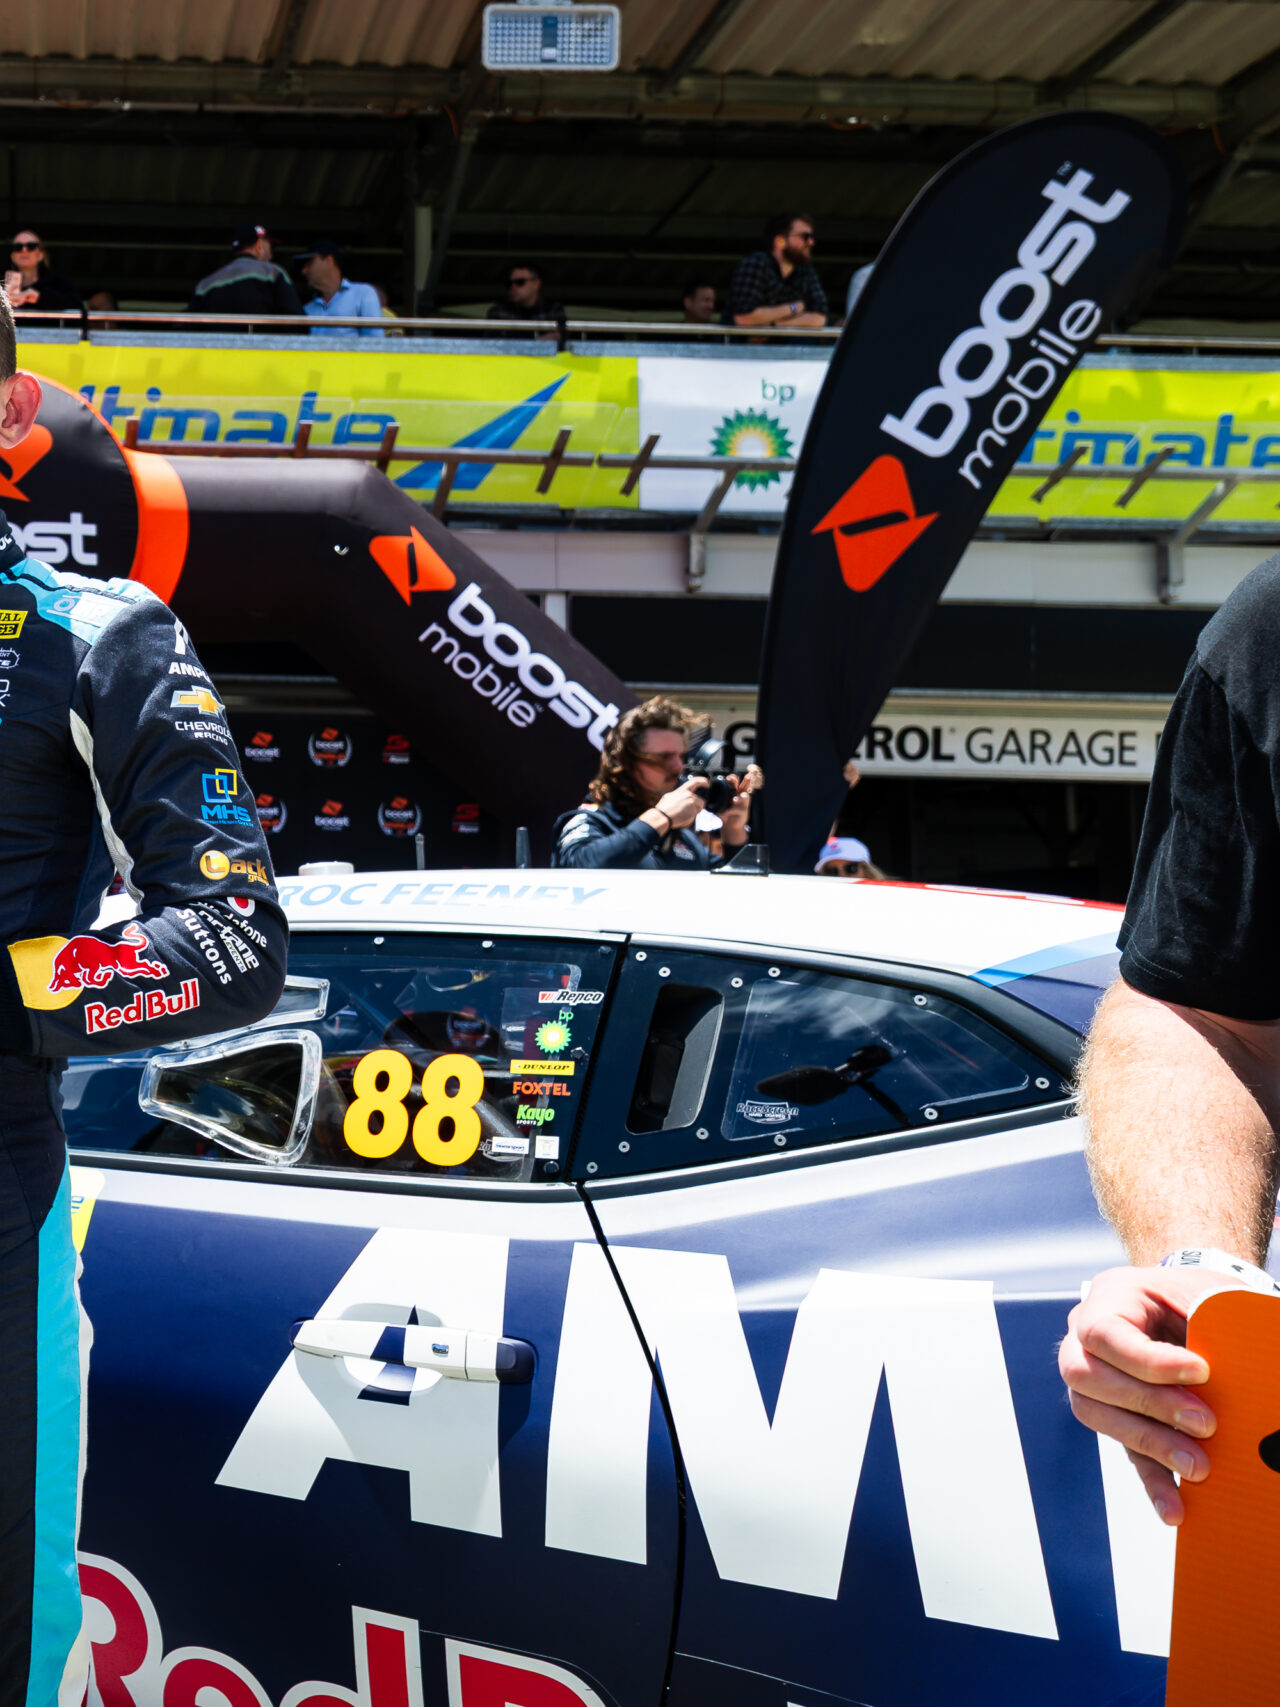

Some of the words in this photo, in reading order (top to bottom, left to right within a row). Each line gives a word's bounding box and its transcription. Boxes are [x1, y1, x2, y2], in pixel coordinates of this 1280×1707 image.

[880, 168, 1131, 457] boost
[761, 378, 796, 402] bp
[958, 299, 1103, 490] mobile
[79, 385, 399, 446] timate
[418, 622, 537, 728] mobile
[447, 582, 621, 752] boost
[174, 720, 233, 741] CHEVROLE
[193, 731, 229, 746] RACING
[965, 726, 1137, 766] GARAGE
[200, 804, 252, 822] MHS
[277, 882, 379, 907] ROC
[175, 907, 233, 985] Suttons
[224, 939, 246, 972] EVENTS
[84, 991, 144, 1035] Red
[145, 977, 200, 1021] Bull
[556, 988, 605, 1006] Repco
[558, 1009, 575, 1023] bp
[521, 1062, 571, 1072] DUNLOP
[512, 1081, 572, 1097] FOXTEL
[342, 1049, 485, 1167] 88
[516, 1104, 556, 1127] Kayo
